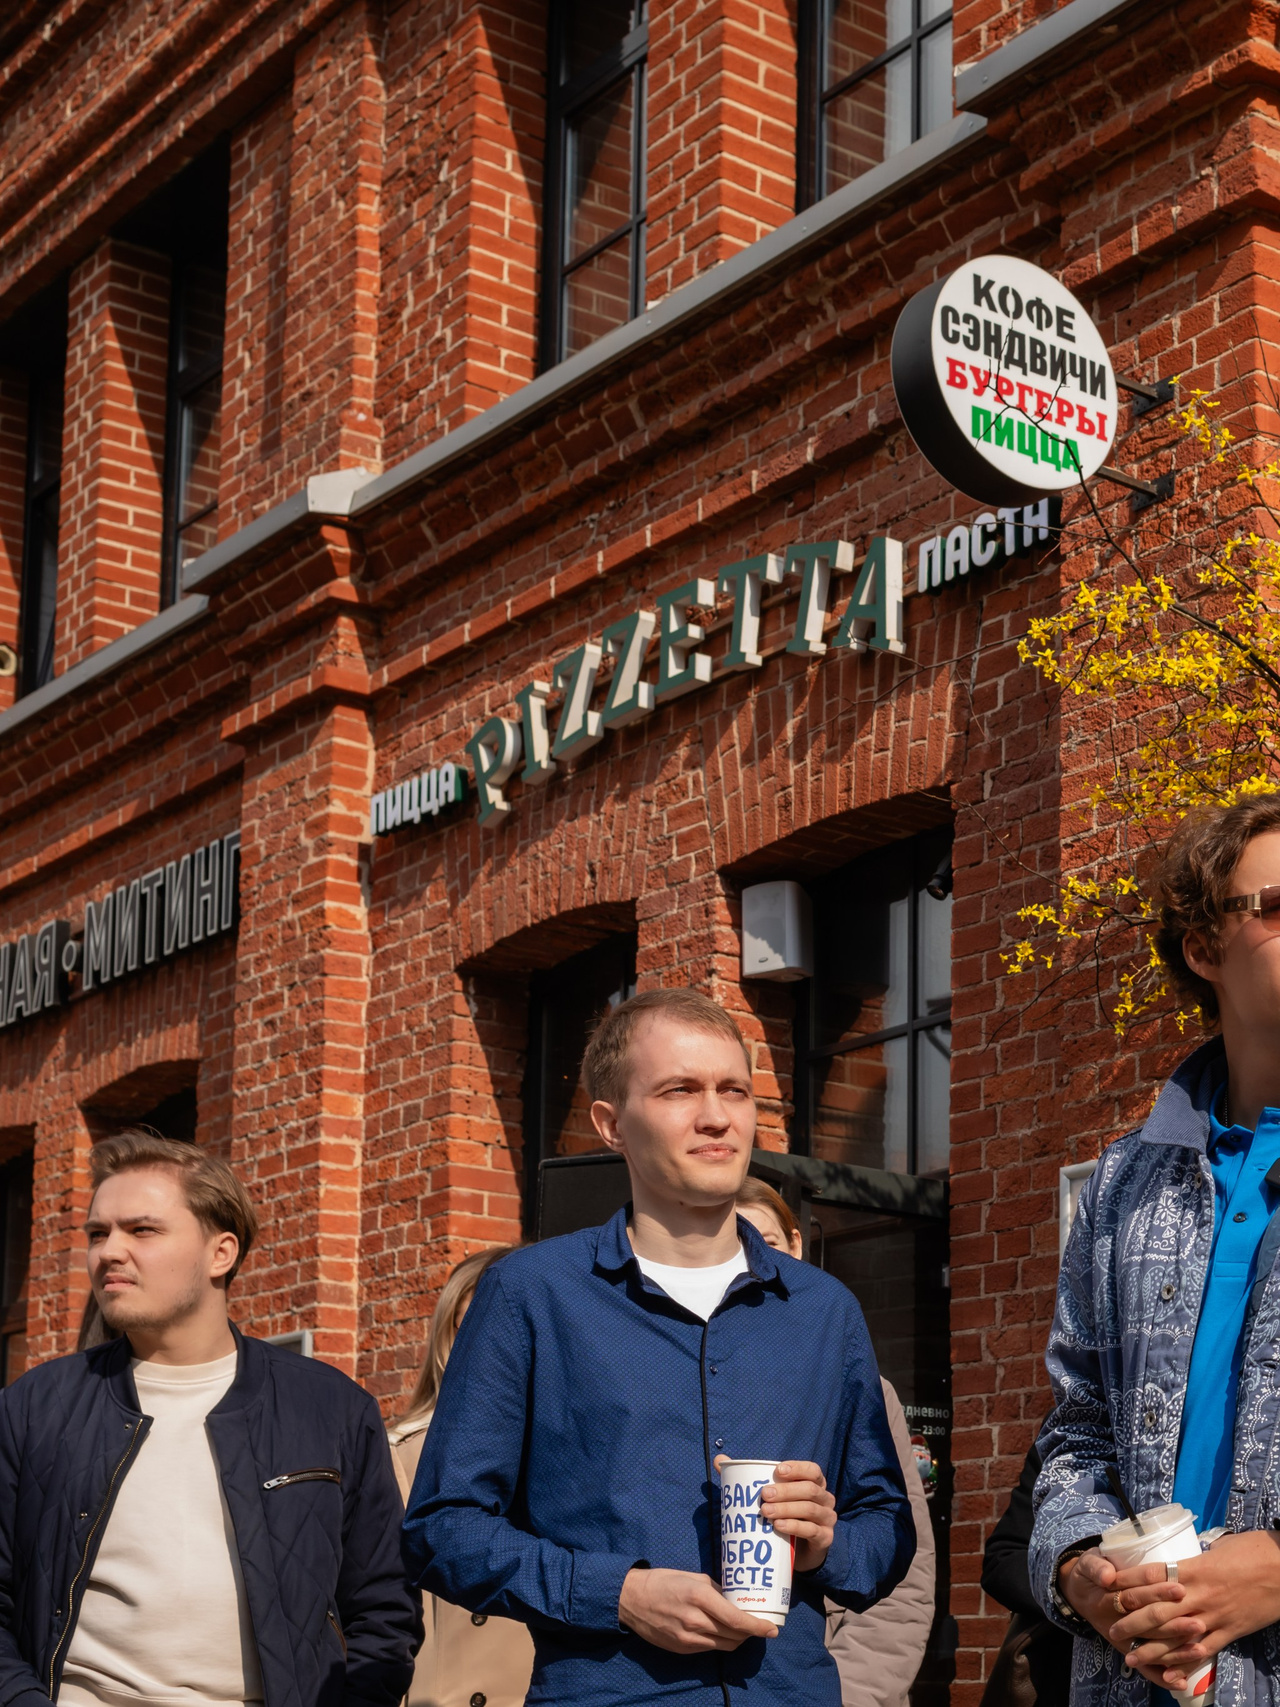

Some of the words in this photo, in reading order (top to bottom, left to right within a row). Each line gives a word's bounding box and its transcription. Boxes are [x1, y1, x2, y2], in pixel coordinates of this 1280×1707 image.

[972, 273, 1076, 343] КОФЕ
[940, 305, 1107, 400] СЭНДВИЧИ
[945, 356, 1108, 442] БУРГЕРЫ
[971, 405, 1082, 473] ПИЦЦА
[465, 536, 906, 829] PIZZETTA
[370, 762, 455, 836] ПИЦЦА
[83, 829, 241, 991] МИТИНГ
[922, 1425, 946, 1435] 23:00
[722, 1566, 774, 1588] ЕСТЕ
